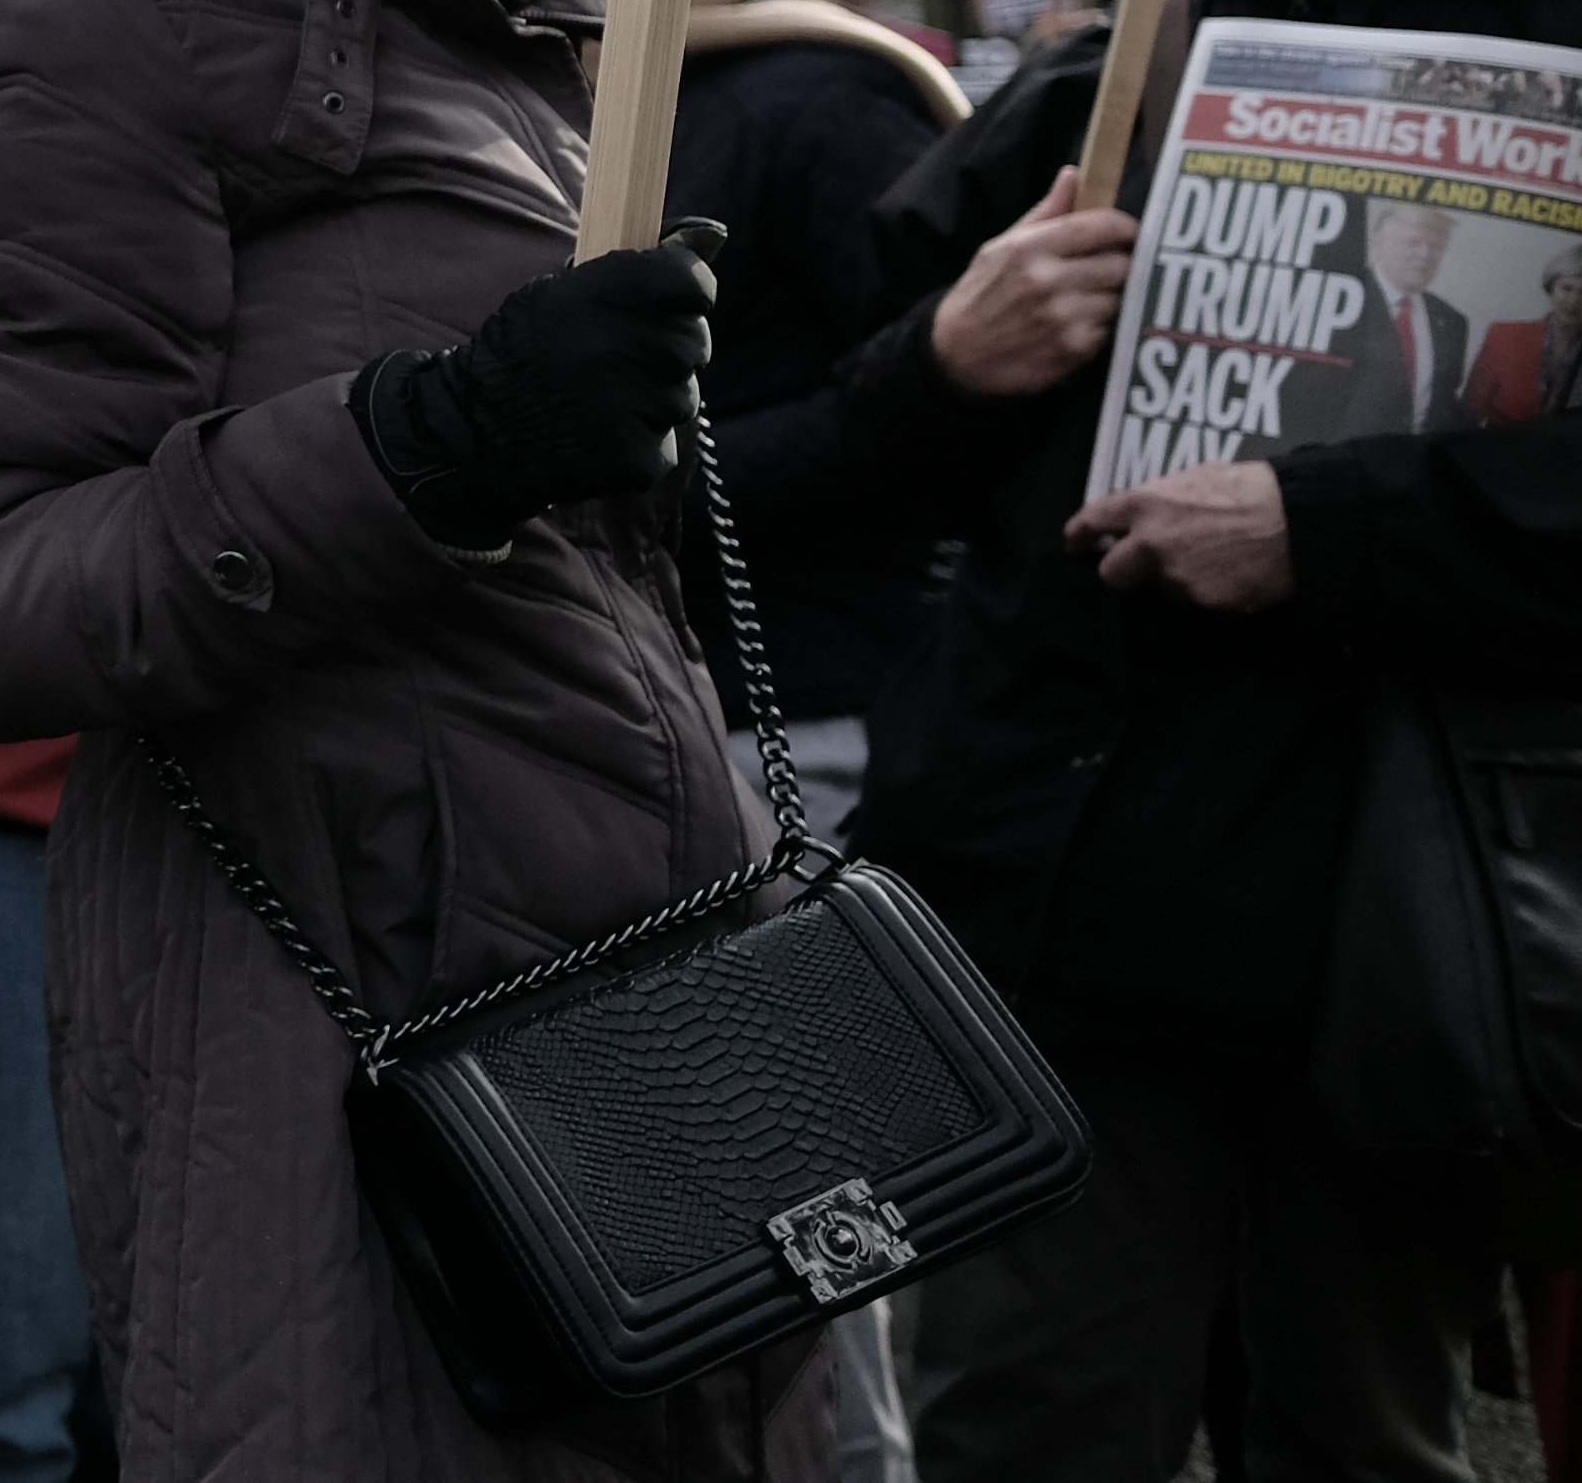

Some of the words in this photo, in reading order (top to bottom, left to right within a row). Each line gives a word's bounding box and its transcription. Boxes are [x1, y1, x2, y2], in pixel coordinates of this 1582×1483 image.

[1223, 91, 1448, 163] Socialist
[1159, 173, 1348, 270] DUMP
[1183, 151, 1275, 184] UNITED
[1277, 161, 1306, 186] IN
[1309, 165, 1427, 201] BIGOTRY
[1426, 179, 1489, 214] AND
[1491, 188, 1582, 231] RACIS
[1149, 252, 1366, 355] TRUMP
[1131, 335, 1296, 438] SACK
